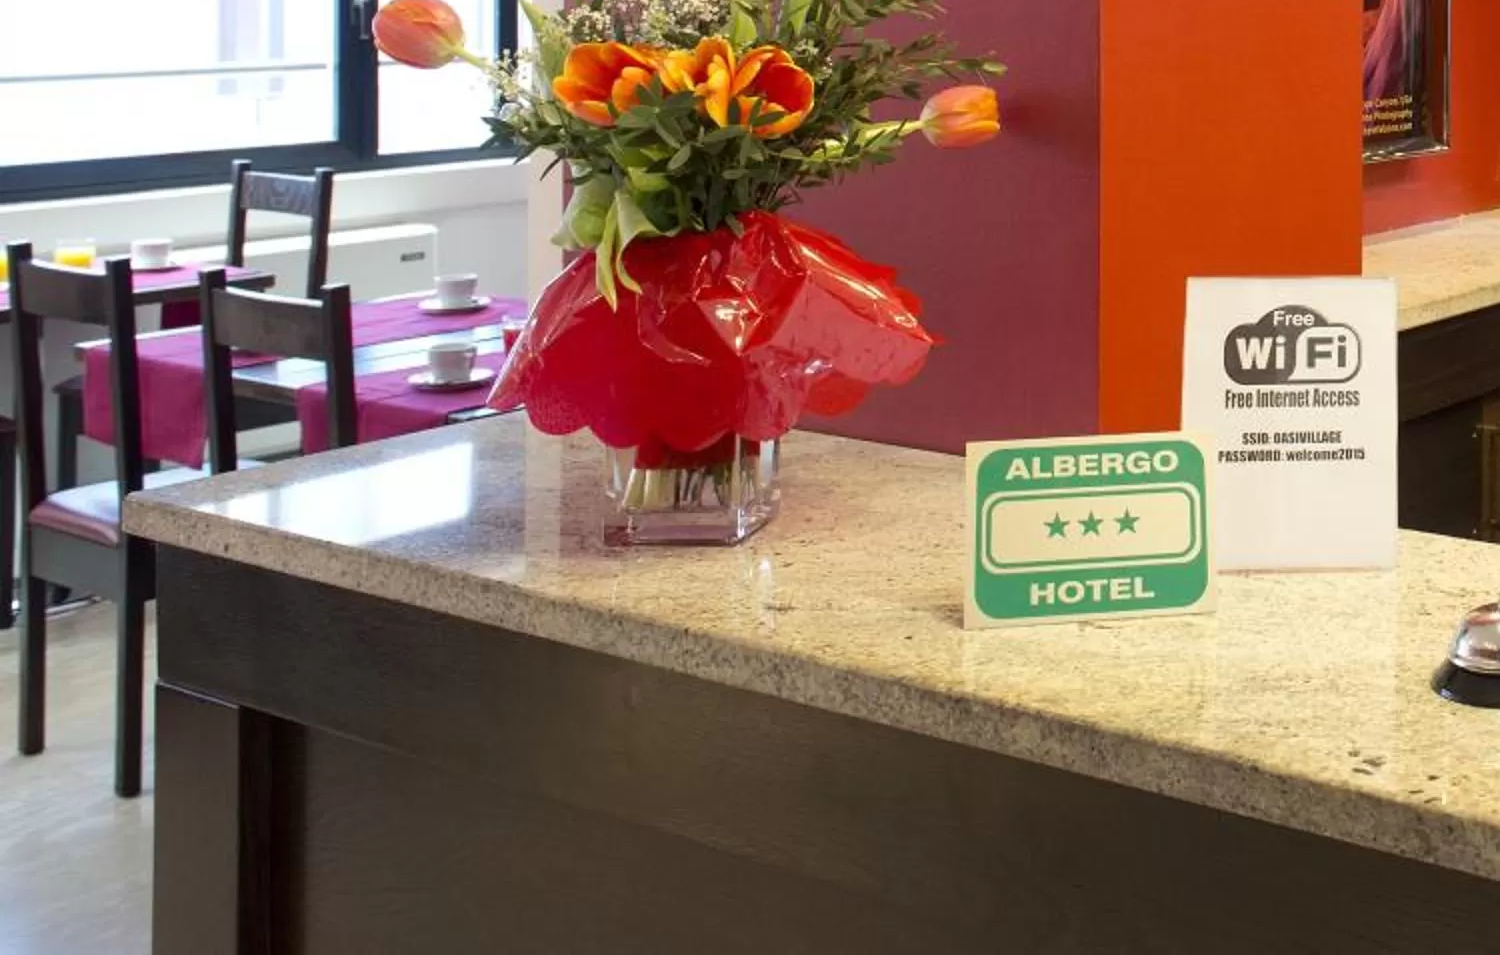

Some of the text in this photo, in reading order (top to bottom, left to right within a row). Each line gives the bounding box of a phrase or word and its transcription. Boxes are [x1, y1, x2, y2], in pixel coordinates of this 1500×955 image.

[1272, 309, 1316, 327] Free
[1224, 387, 1361, 410] Free Internet Access
[1273, 430, 1343, 444] OASIVILLAGE
[1285, 447, 1366, 462] welcome2015
[1004, 449, 1180, 482] ALBERGO
[1028, 575, 1156, 607] HOTEL
